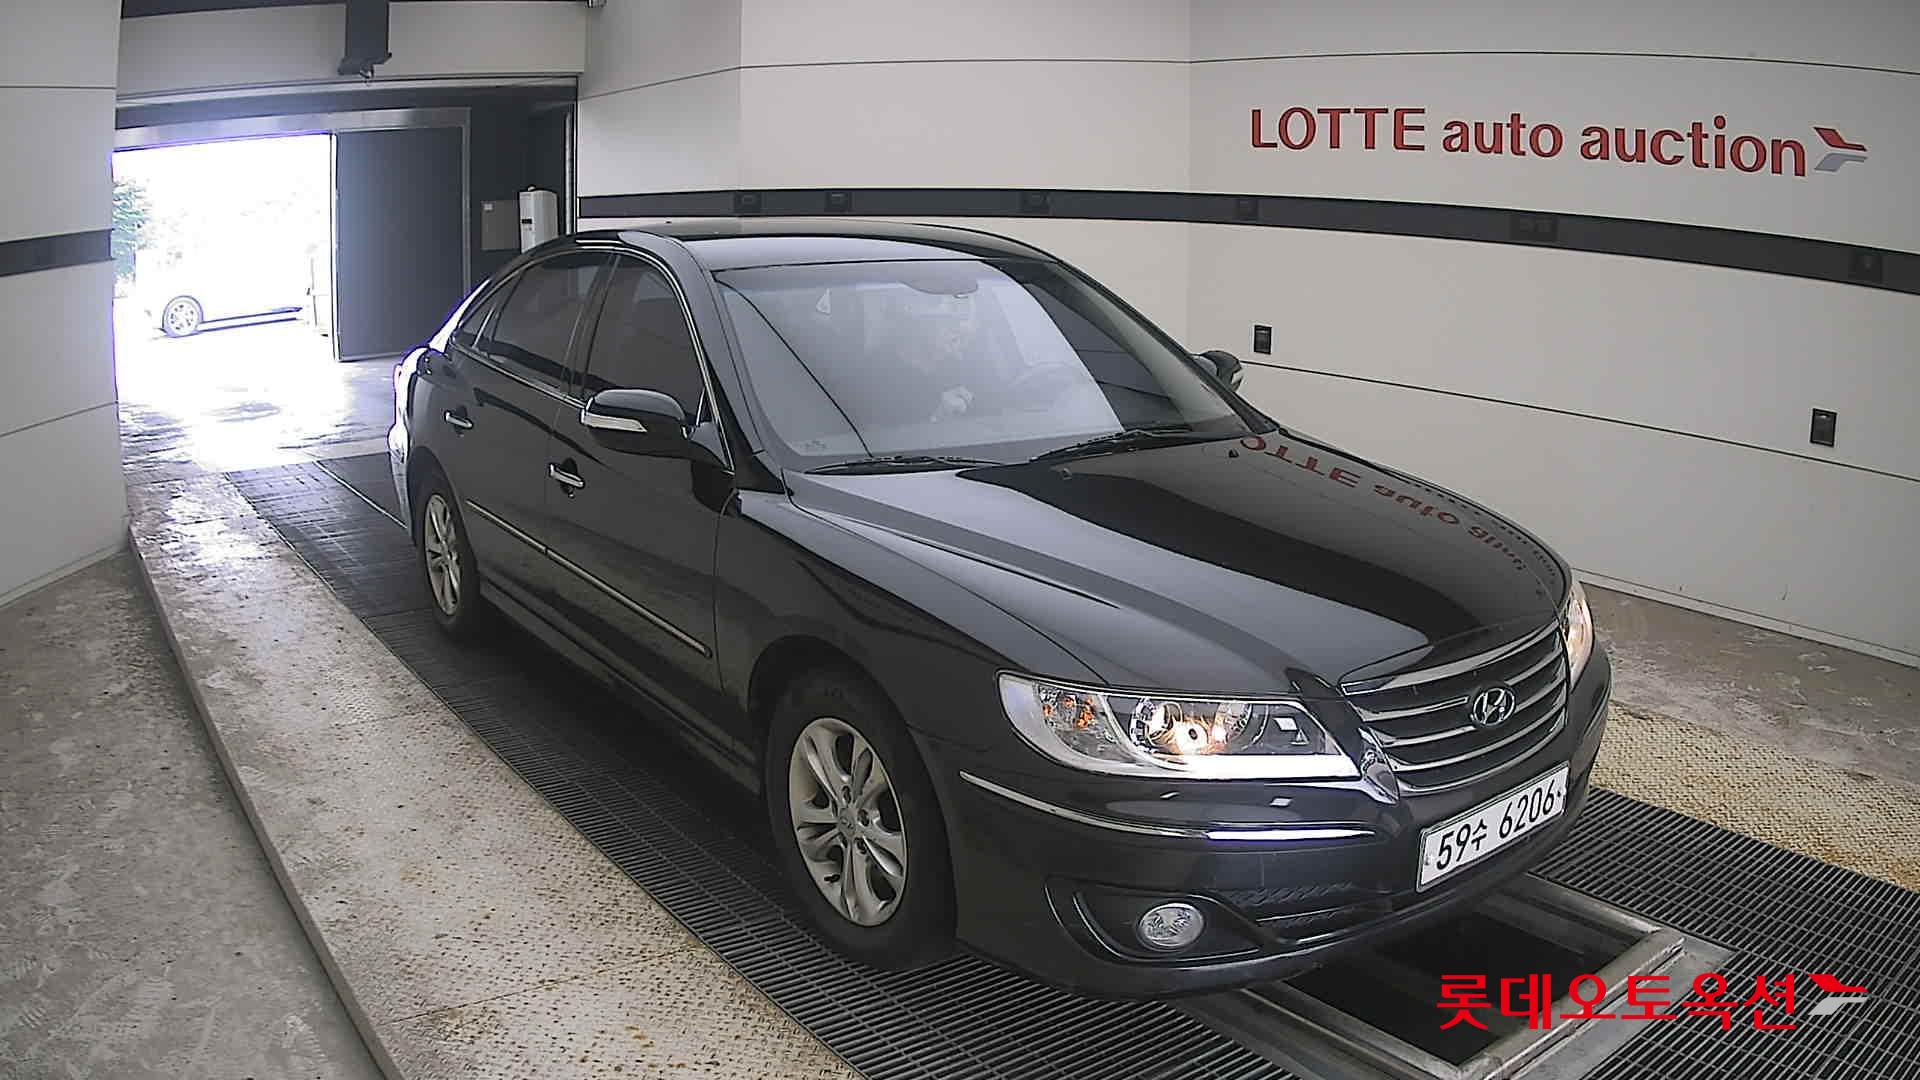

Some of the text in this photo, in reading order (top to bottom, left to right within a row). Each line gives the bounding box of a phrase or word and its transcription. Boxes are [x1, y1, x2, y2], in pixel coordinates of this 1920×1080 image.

[1251, 107, 1807, 176] LOTTE auto auction
[1436, 779, 1555, 870] 59수 6206
